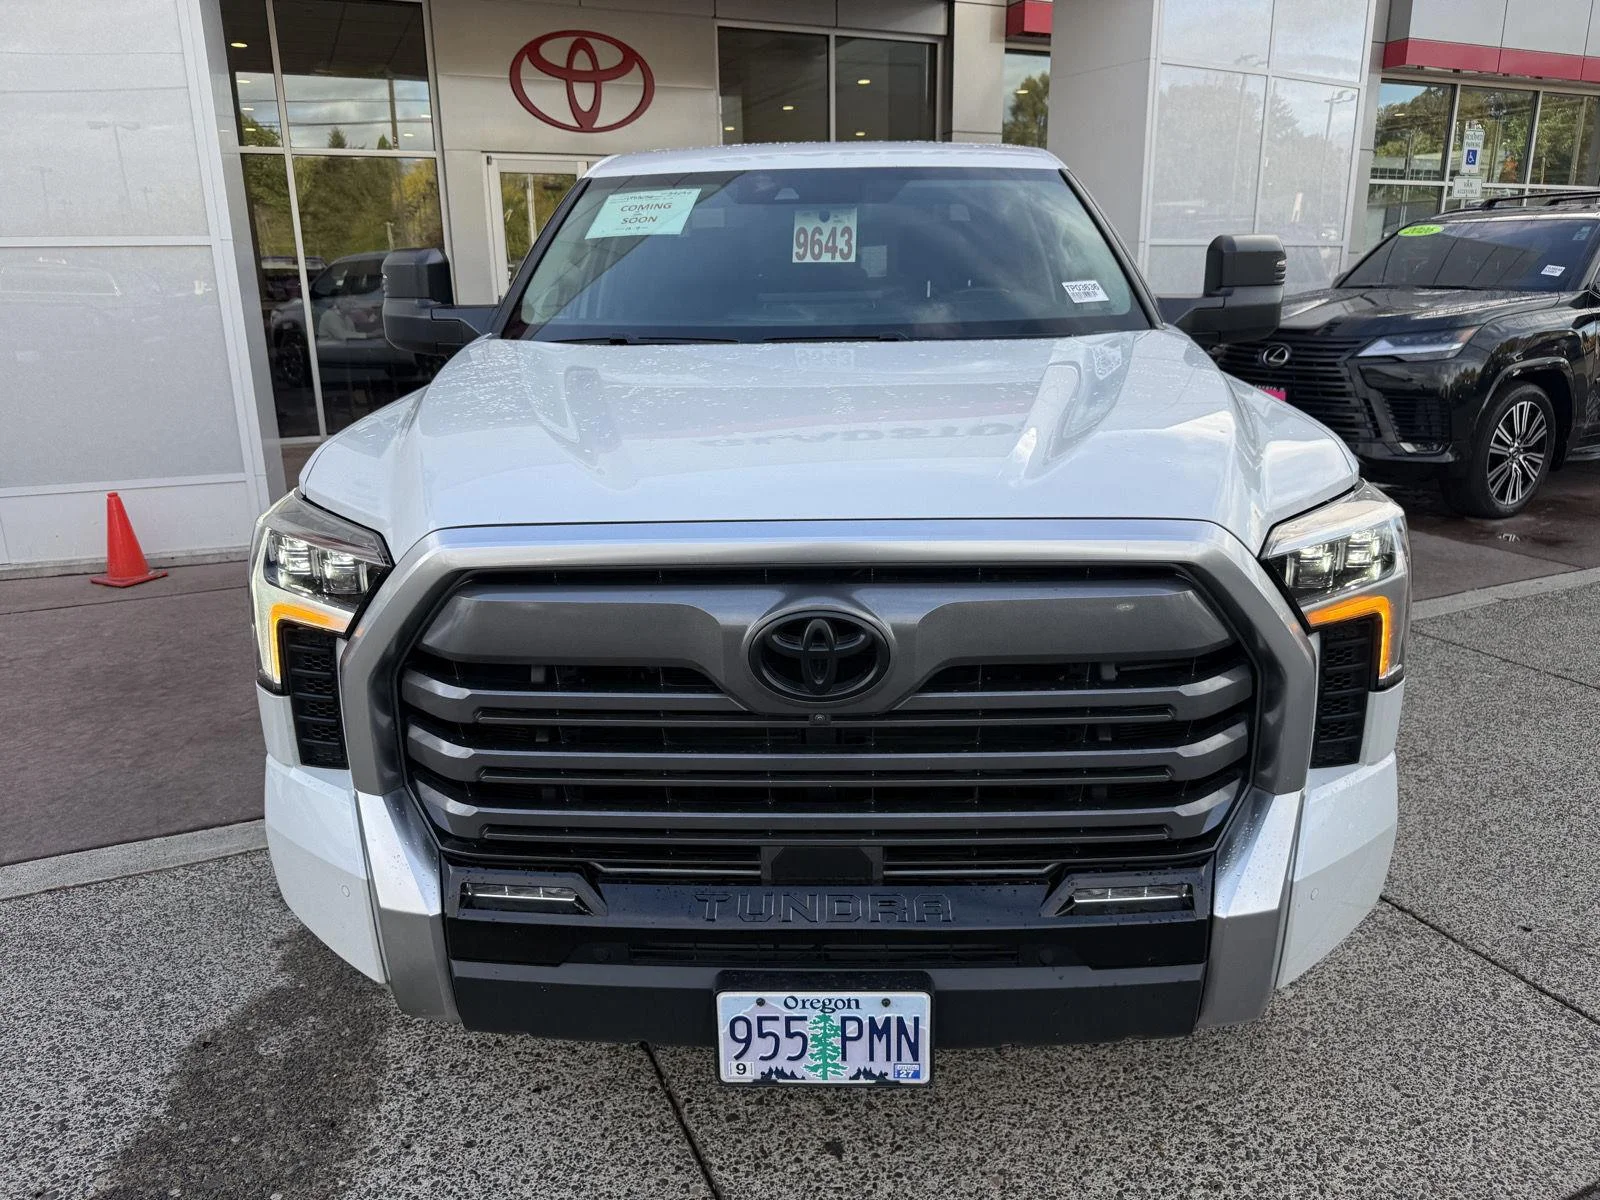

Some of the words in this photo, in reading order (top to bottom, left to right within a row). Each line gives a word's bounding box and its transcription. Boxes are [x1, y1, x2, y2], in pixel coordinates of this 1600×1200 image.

[620, 202, 673, 212] COMING
[621, 215, 658, 225] SOON
[795, 226, 853, 261] 9643
[695, 893, 953, 923] TUNDRA
[783, 995, 863, 1014] Oregon
[729, 1015, 808, 1062] 955
[840, 1015, 920, 1062] PMN
[736, 1063, 747, 1075] 9
[899, 1070, 914, 1078] 27
